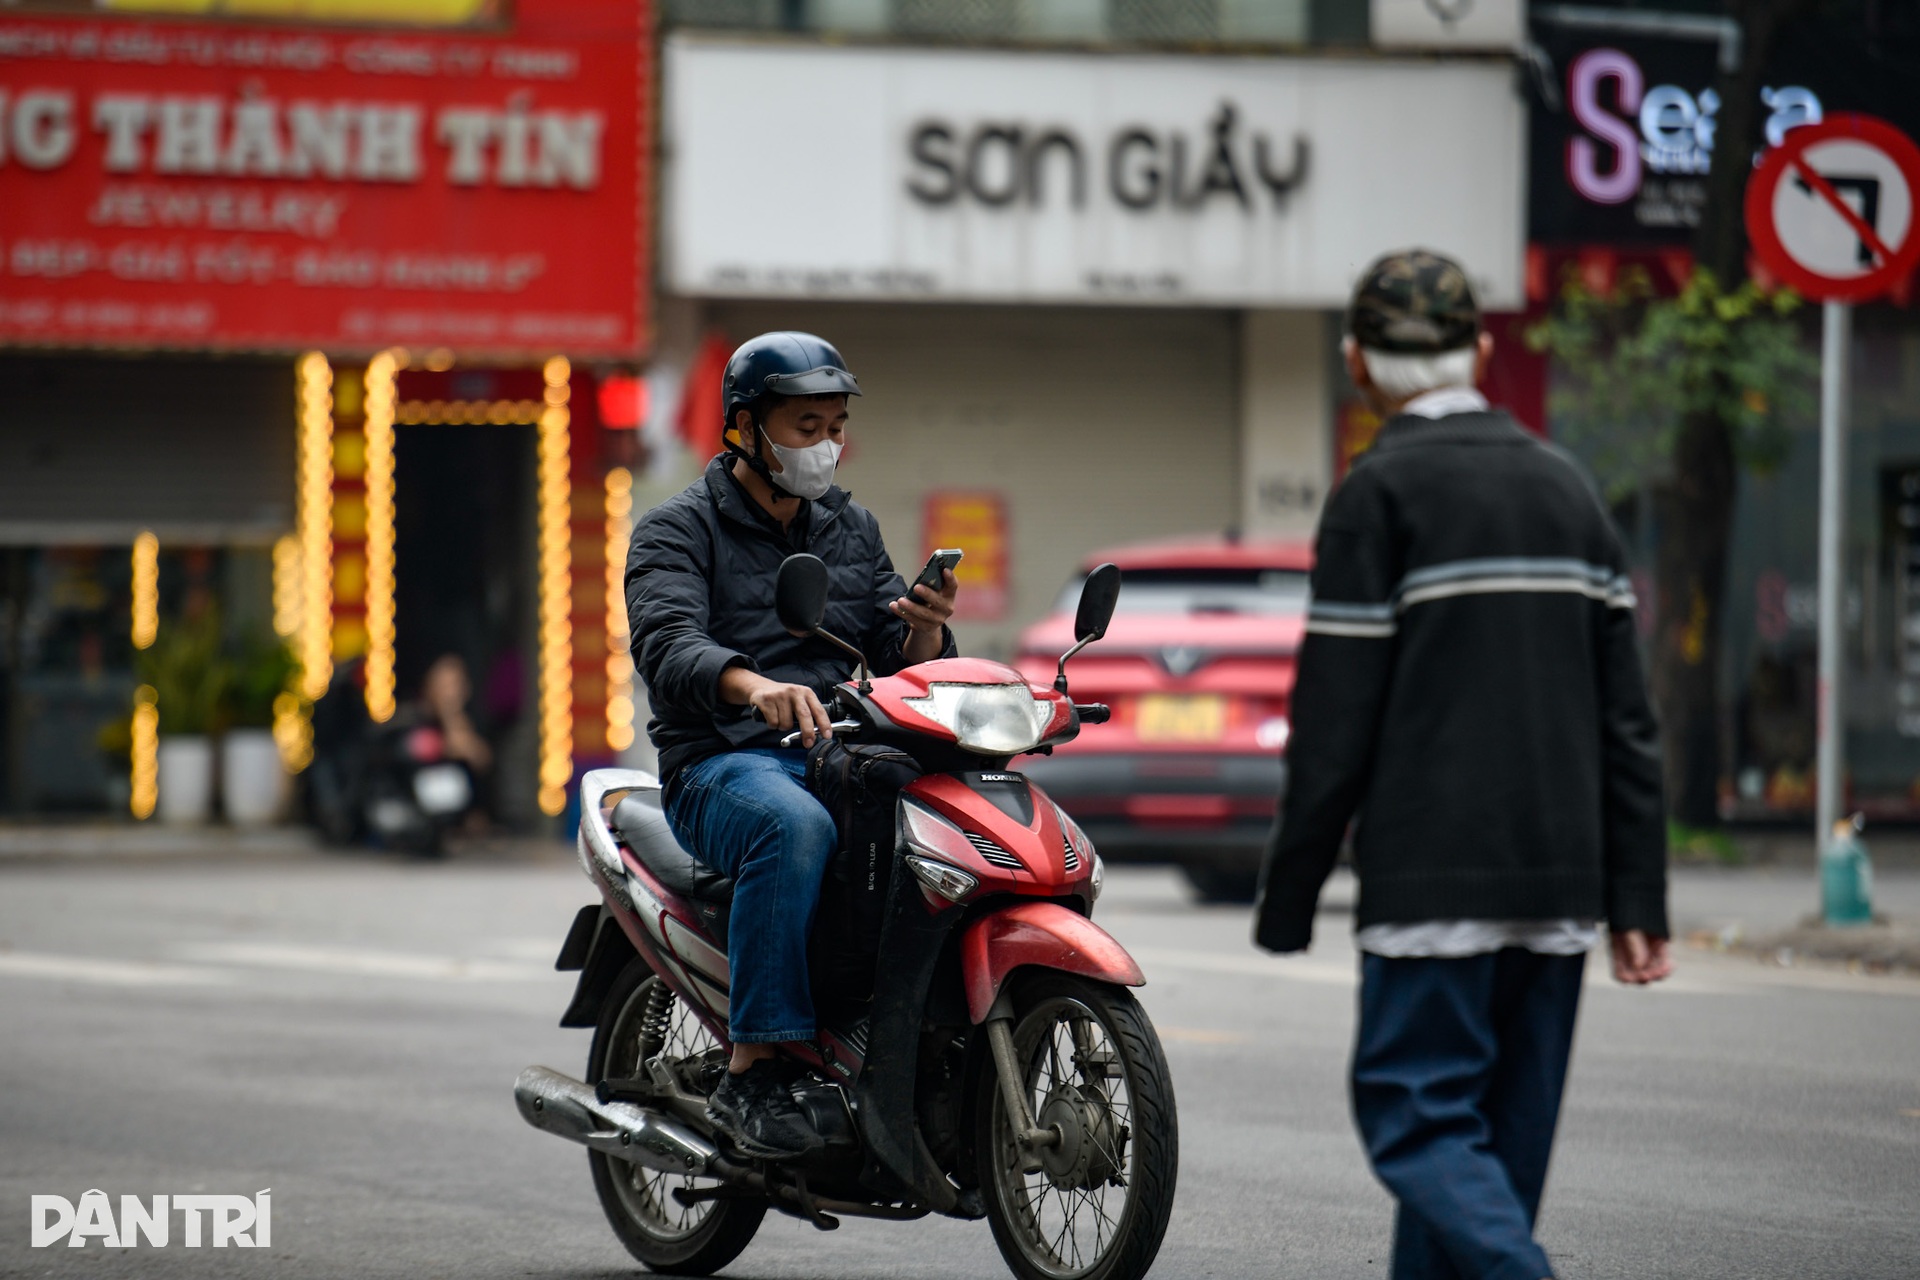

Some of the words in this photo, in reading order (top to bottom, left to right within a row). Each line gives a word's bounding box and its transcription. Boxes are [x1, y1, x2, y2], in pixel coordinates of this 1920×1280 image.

[438, 90, 605, 190] TÍN
[90, 186, 345, 236] JEWELRY
[981, 774, 1023, 783] HONDA
[869, 842, 877, 861] LEAD
